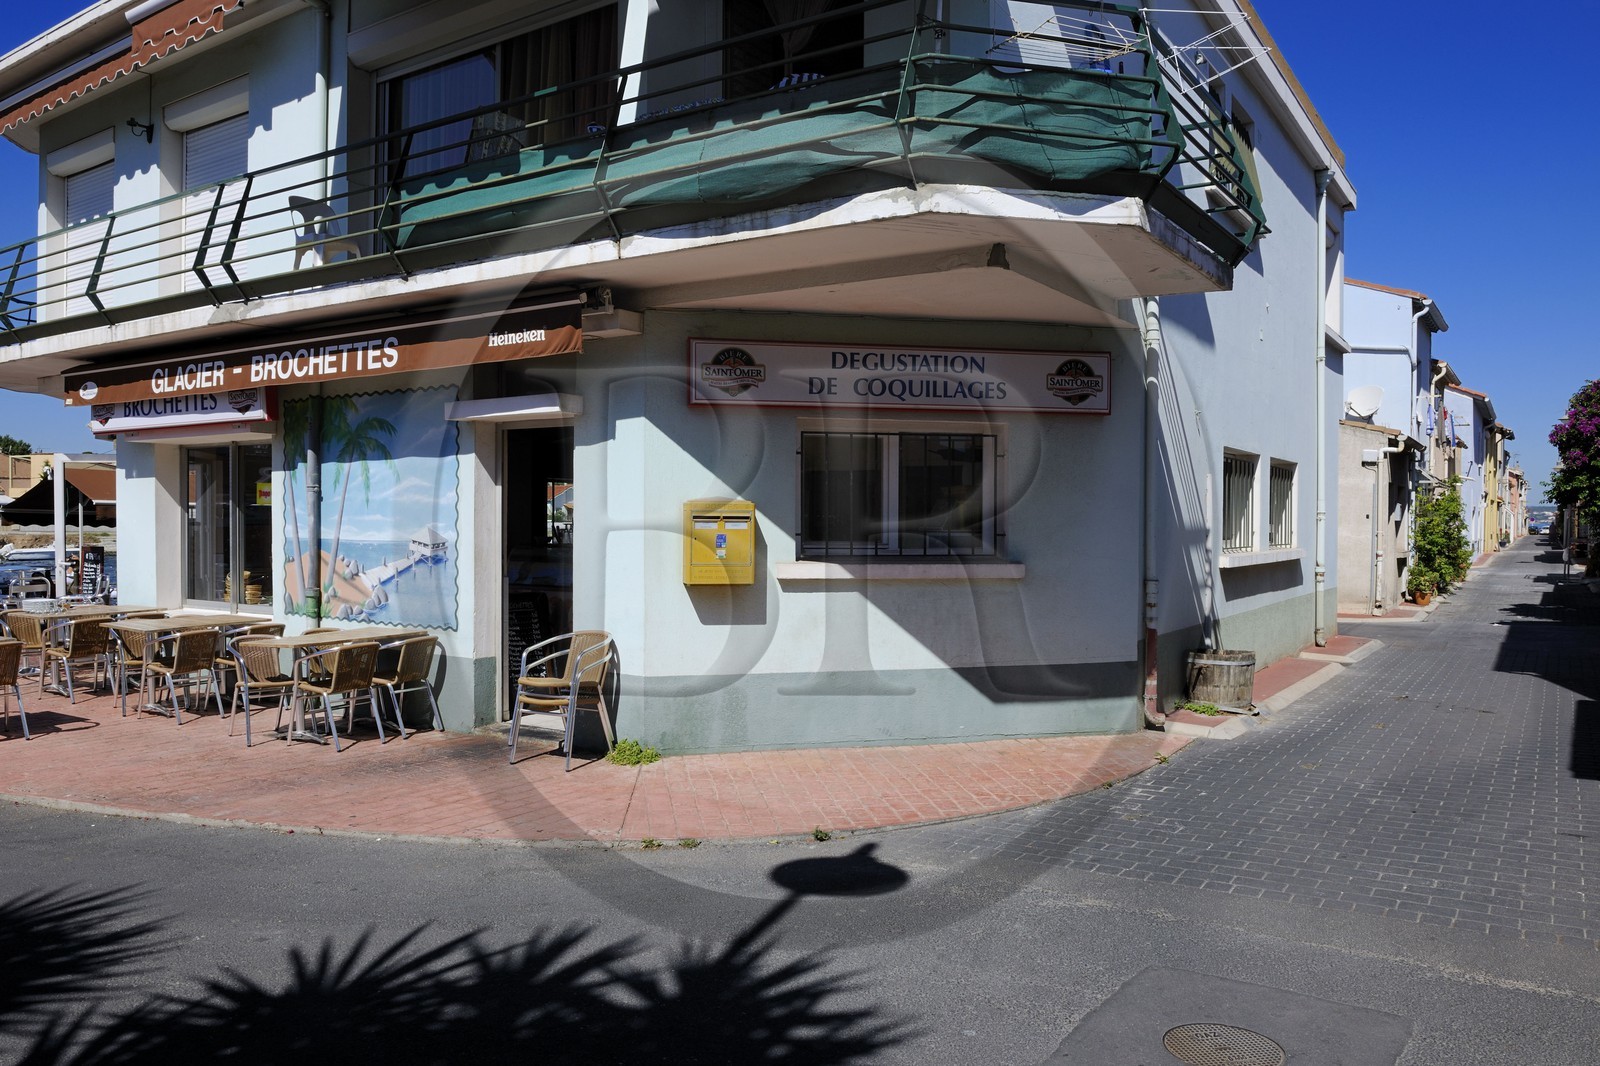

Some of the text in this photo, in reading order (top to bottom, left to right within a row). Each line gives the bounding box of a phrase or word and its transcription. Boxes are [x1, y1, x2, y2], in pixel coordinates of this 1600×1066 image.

[488, 328, 546, 347] Heineken
[151, 360, 225, 394] GLACIER
[250, 336, 400, 383] BROCHETTES
[831, 351, 986, 374] DEGUSTATION
[808, 376, 1008, 402] DE COQUILLAGES
[1194, 1031, 1221, 1039] GAZ
